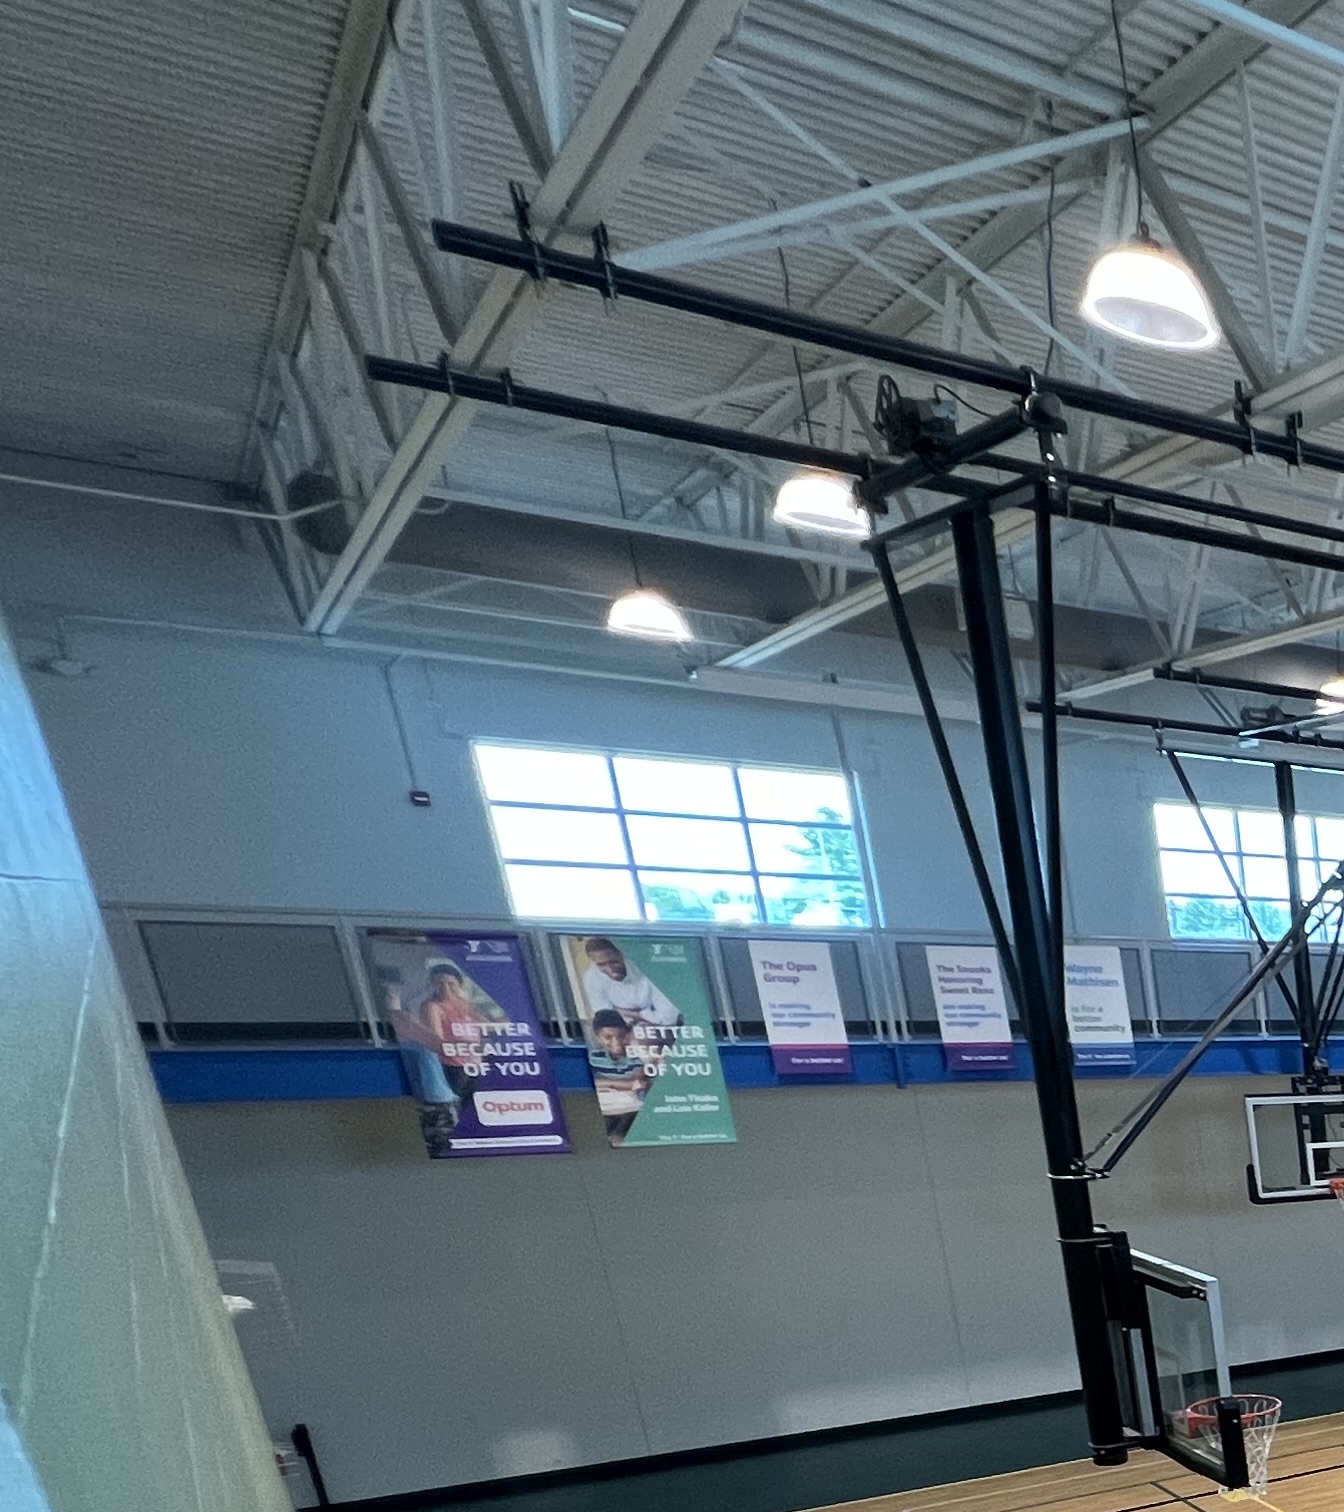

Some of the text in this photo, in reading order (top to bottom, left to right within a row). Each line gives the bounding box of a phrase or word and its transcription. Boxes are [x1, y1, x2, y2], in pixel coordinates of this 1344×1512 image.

[760, 960, 818, 973] The Opus
[763, 973, 800, 985] Group
[451, 1022, 532, 1037] BETTER
[632, 1025, 704, 1040] BETTER
[441, 1042, 537, 1057] BECAUSE
[625, 1045, 709, 1059] BECAUSE
[463, 1061, 541, 1077] OF YOU
[643, 1062, 712, 1077] OF YOU
[481, 1100, 545, 1115] Optum
